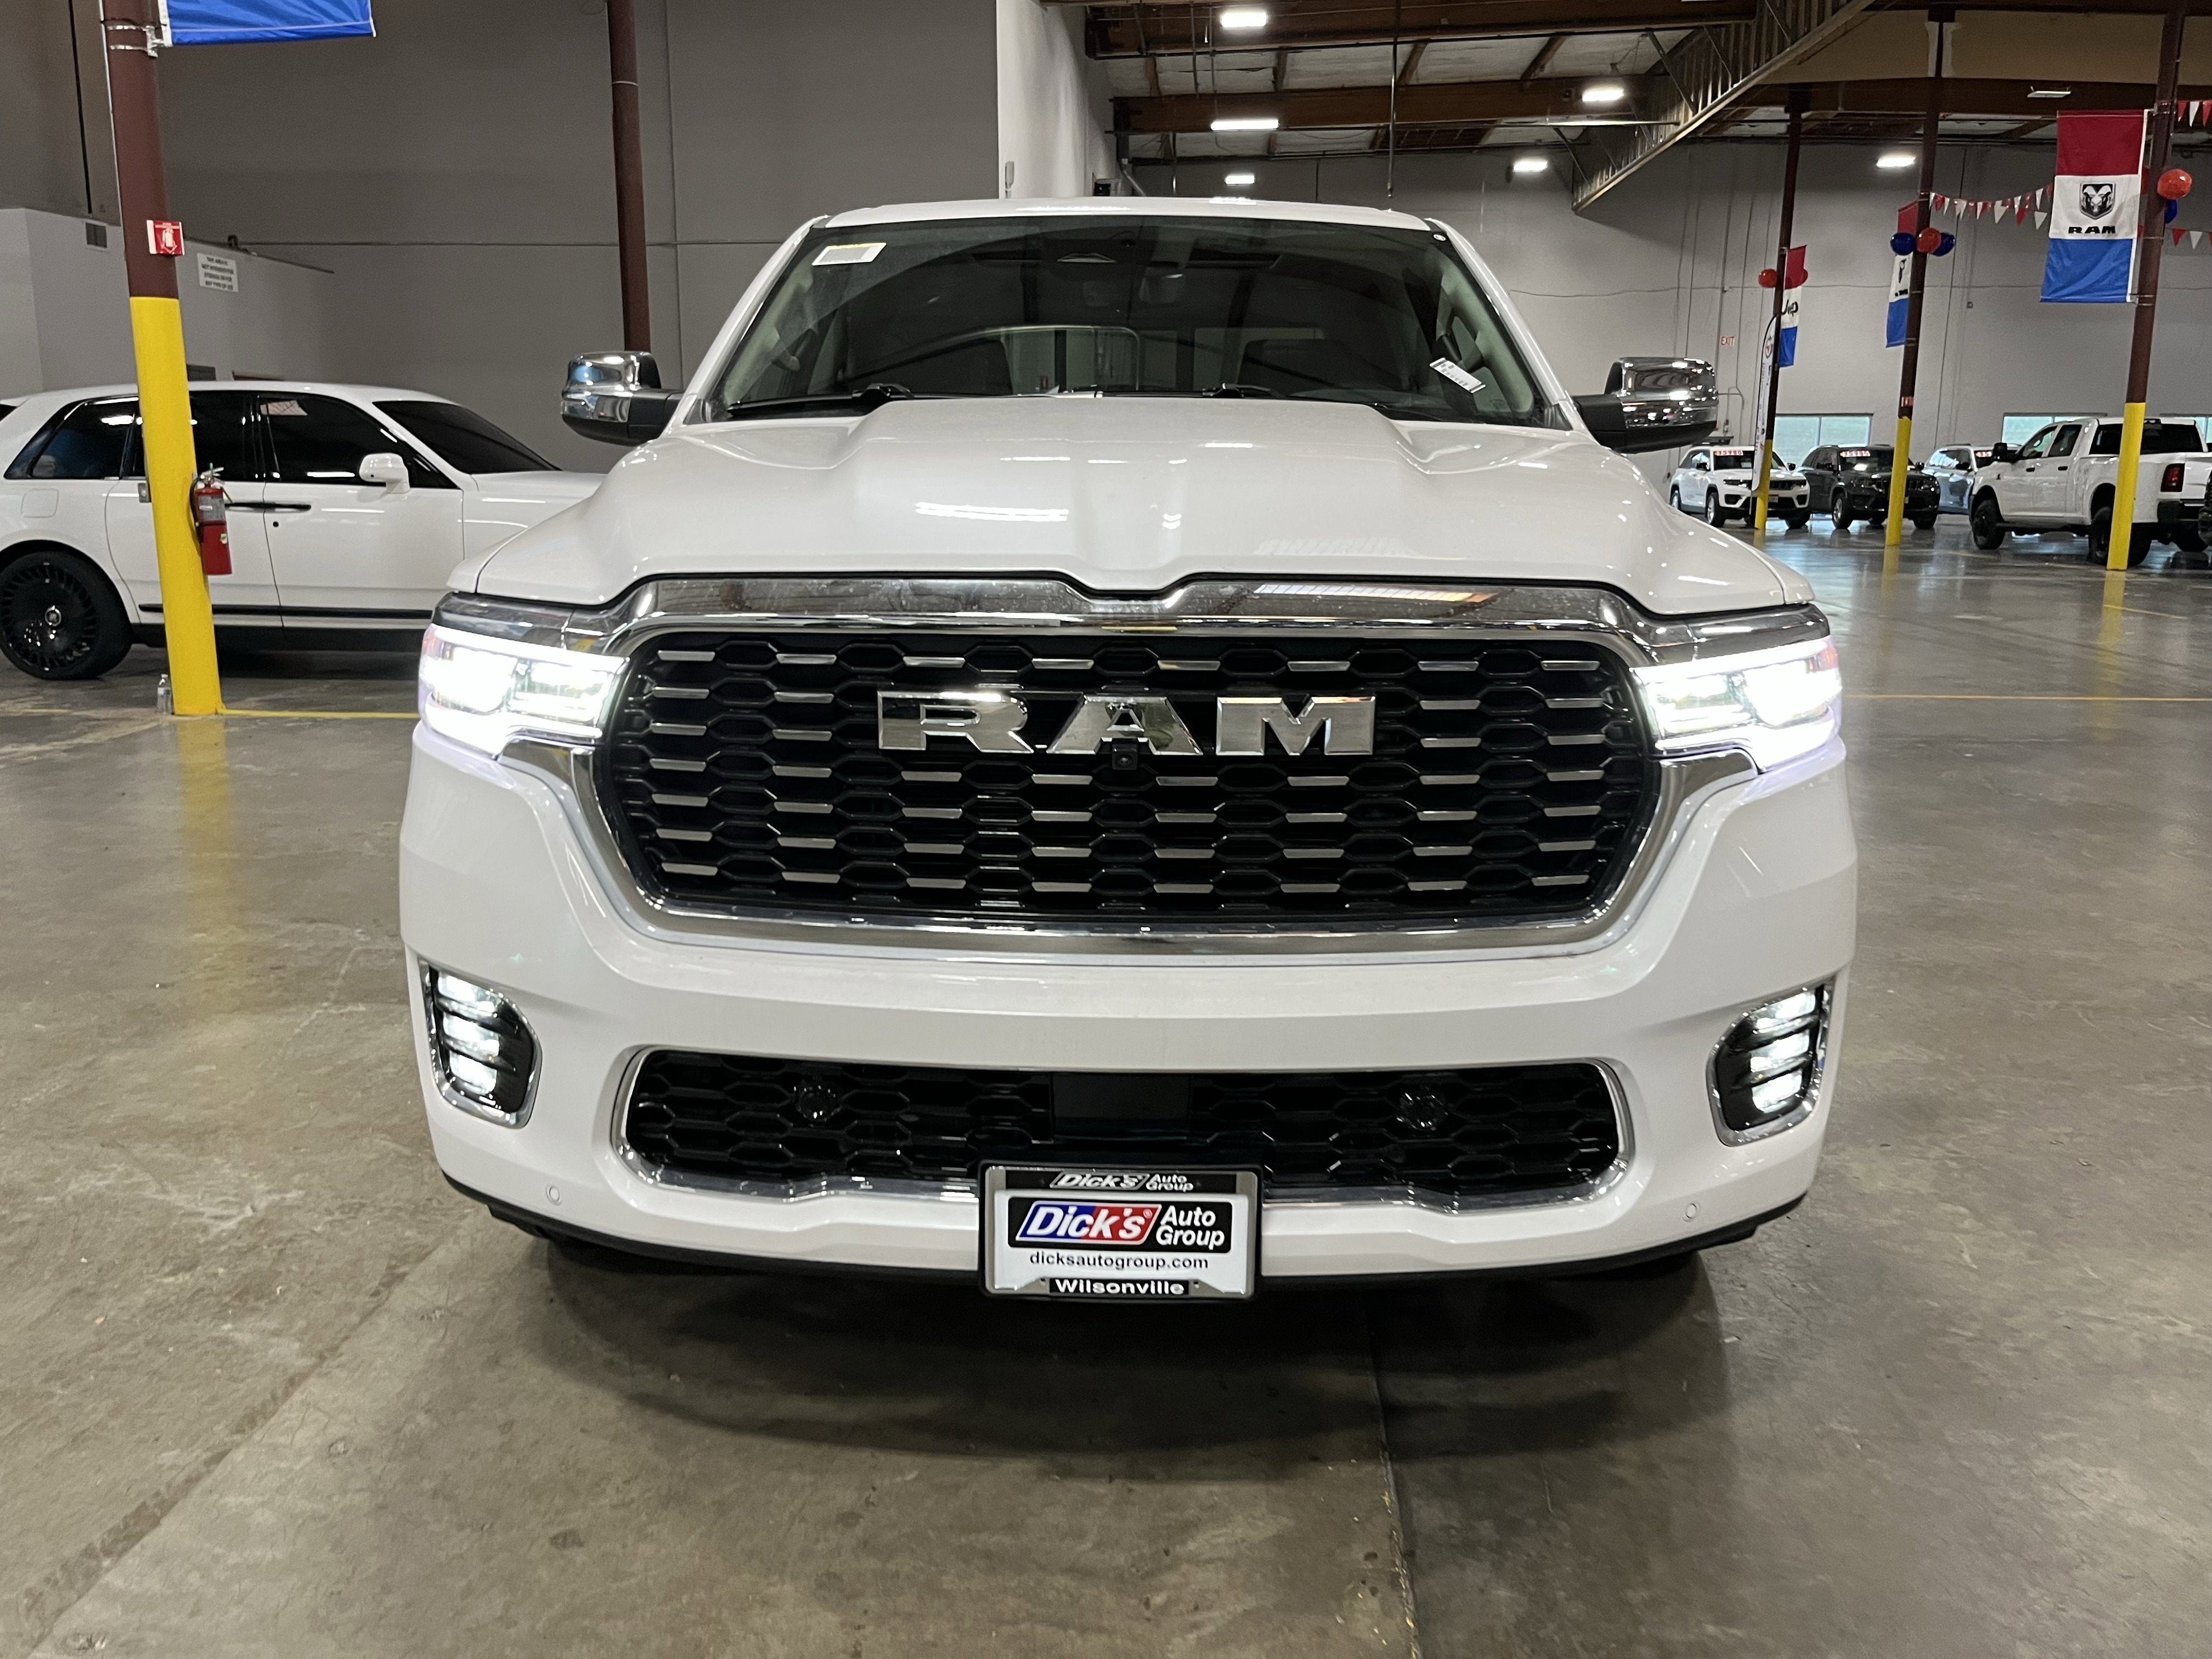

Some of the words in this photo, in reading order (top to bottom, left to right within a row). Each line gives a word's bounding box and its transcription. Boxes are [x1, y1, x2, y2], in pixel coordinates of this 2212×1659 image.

[1721, 336, 1735, 346] EXIT
[878, 690, 1376, 755] RAM
[1146, 1181, 1194, 1192] Group
[1150, 1174, 1187, 1183] Auto
[1026, 1204, 1146, 1239] Dick's
[1160, 1205, 1216, 1227] Auto
[1156, 1226, 1225, 1250] Group
[1030, 1251, 1208, 1271] dicksautogroup.com
[1054, 1279, 1185, 1295] Wilsonville
